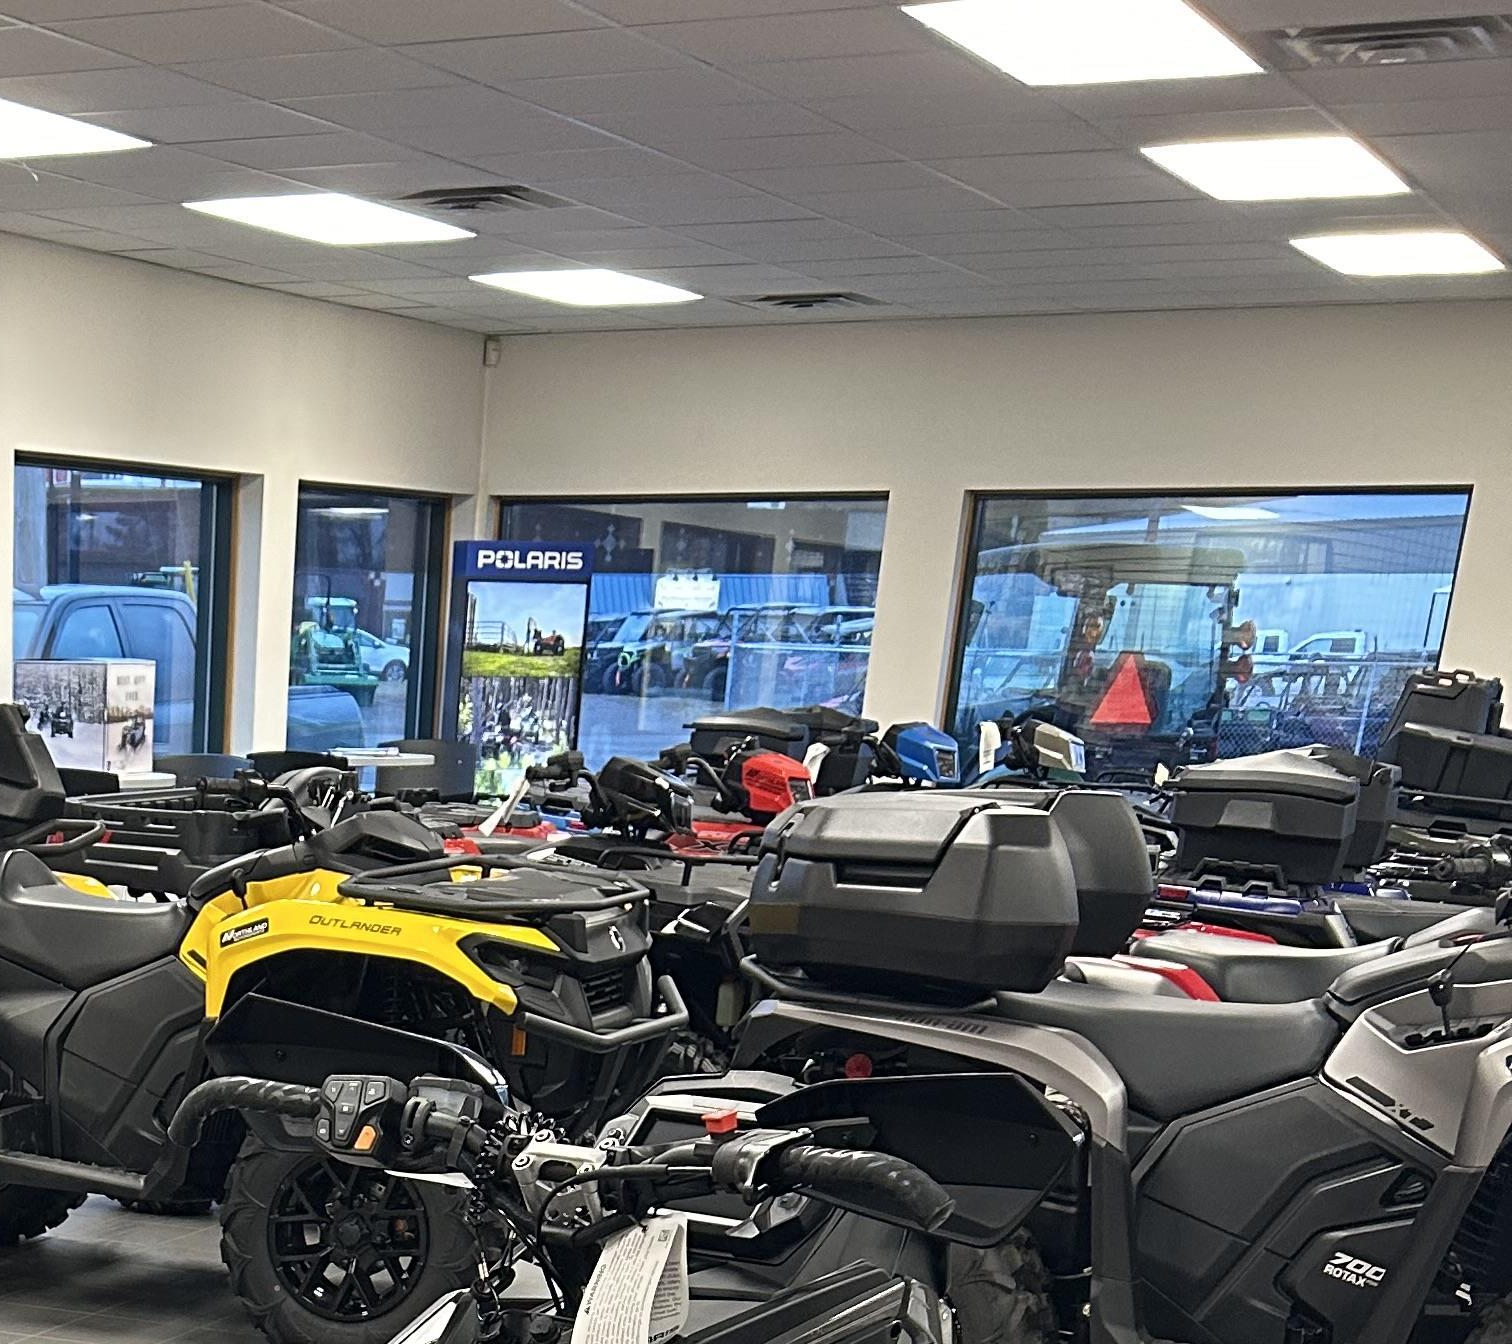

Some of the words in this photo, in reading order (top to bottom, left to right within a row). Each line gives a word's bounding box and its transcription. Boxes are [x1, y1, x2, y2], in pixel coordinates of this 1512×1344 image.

[477, 549, 583, 570] POLARIS
[309, 914, 402, 936] OUTLANDER
[1323, 1264, 1367, 1287] ROTAX
[1329, 1252, 1386, 1281] 700
